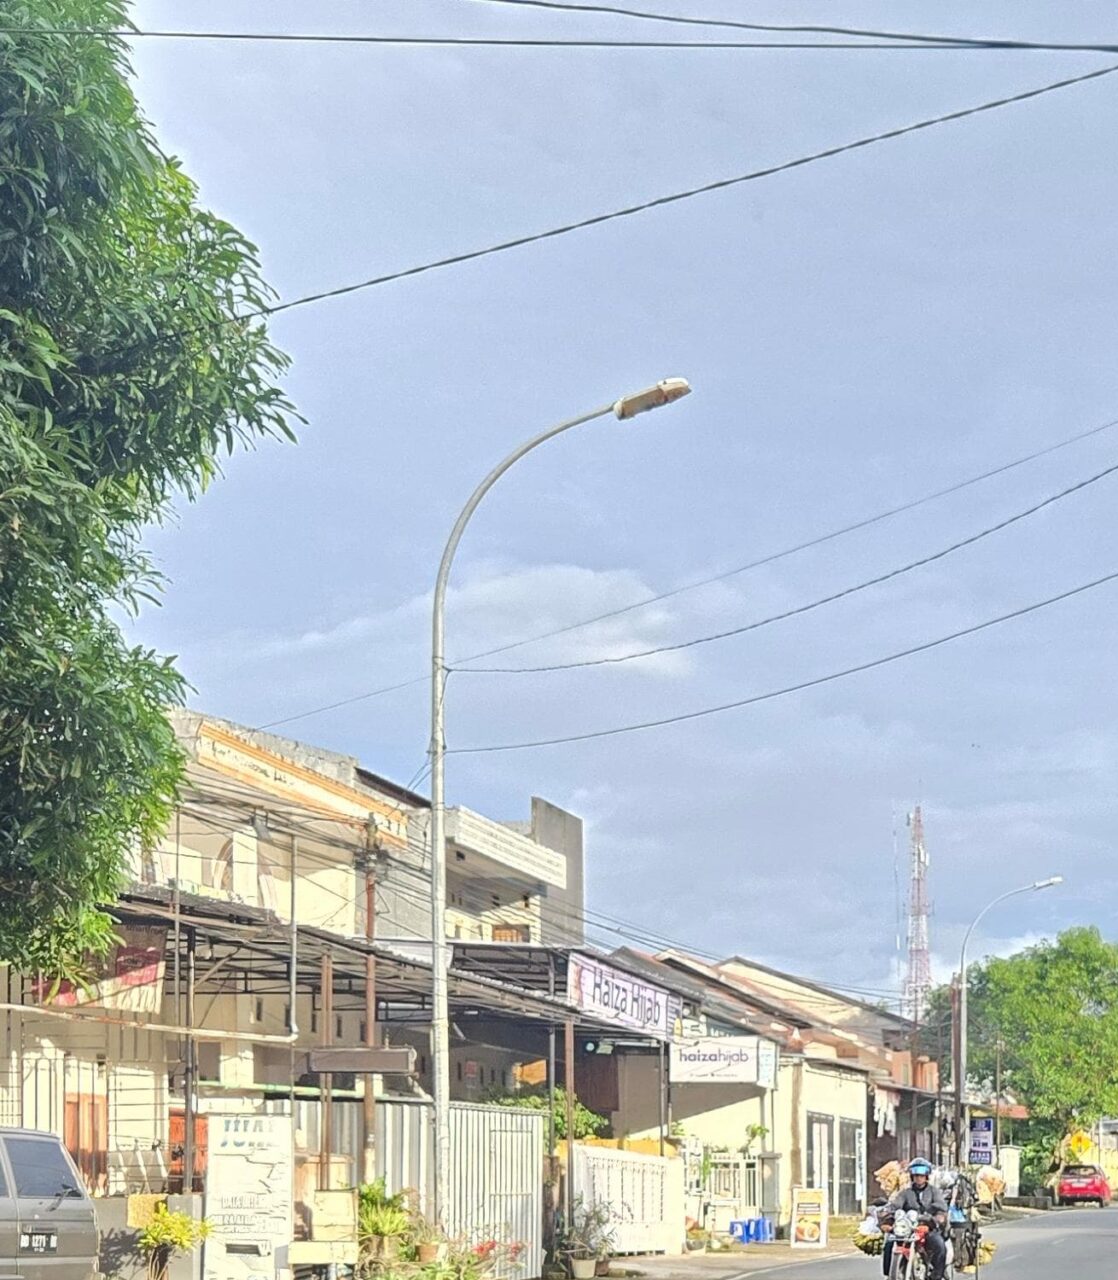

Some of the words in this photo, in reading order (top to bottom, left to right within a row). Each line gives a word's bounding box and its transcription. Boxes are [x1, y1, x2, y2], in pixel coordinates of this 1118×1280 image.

[593, 966, 628, 1015] Haiza
[631, 981, 661, 1026] Hijab
[679, 1048, 749, 1064] haizahijab
